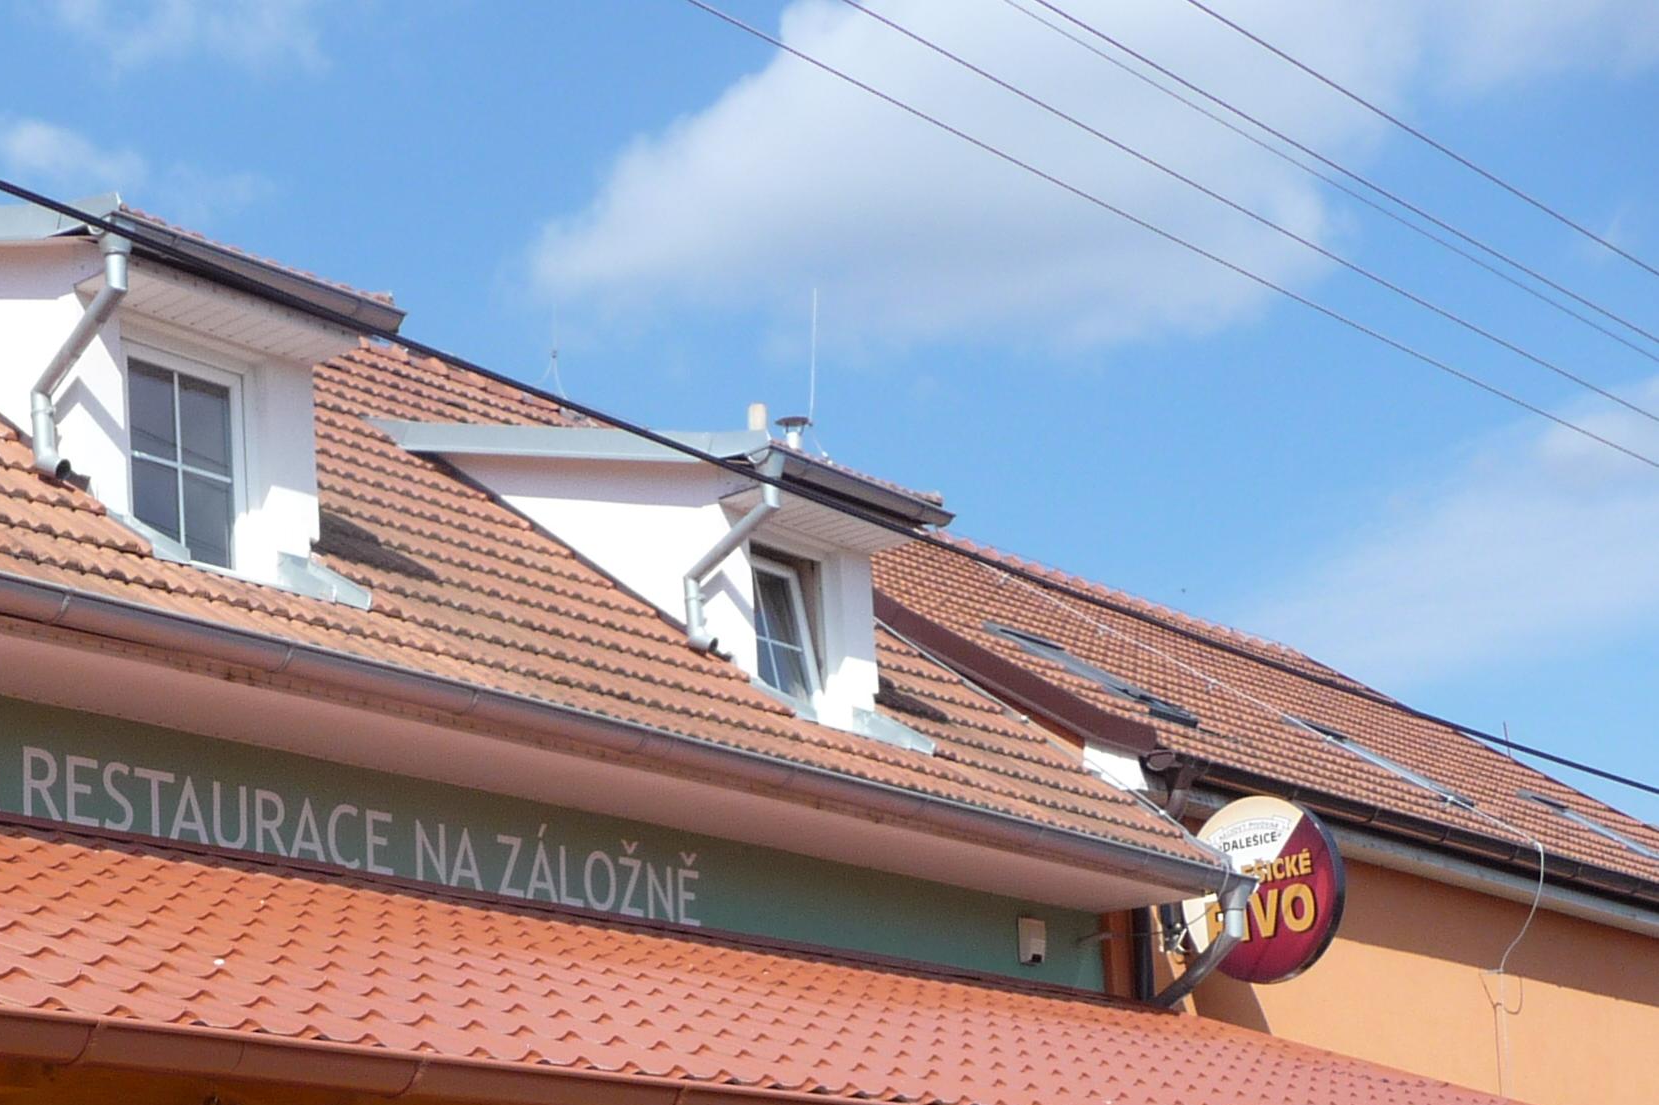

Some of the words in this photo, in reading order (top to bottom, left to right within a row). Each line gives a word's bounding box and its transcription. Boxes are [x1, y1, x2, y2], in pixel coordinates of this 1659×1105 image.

[22, 745, 394, 876] RESTAURACE
[415, 818, 484, 892] NA
[496, 822, 702, 927] ZÁLOŽNĚ
[1240, 848, 1312, 884] EŠICKÉ
